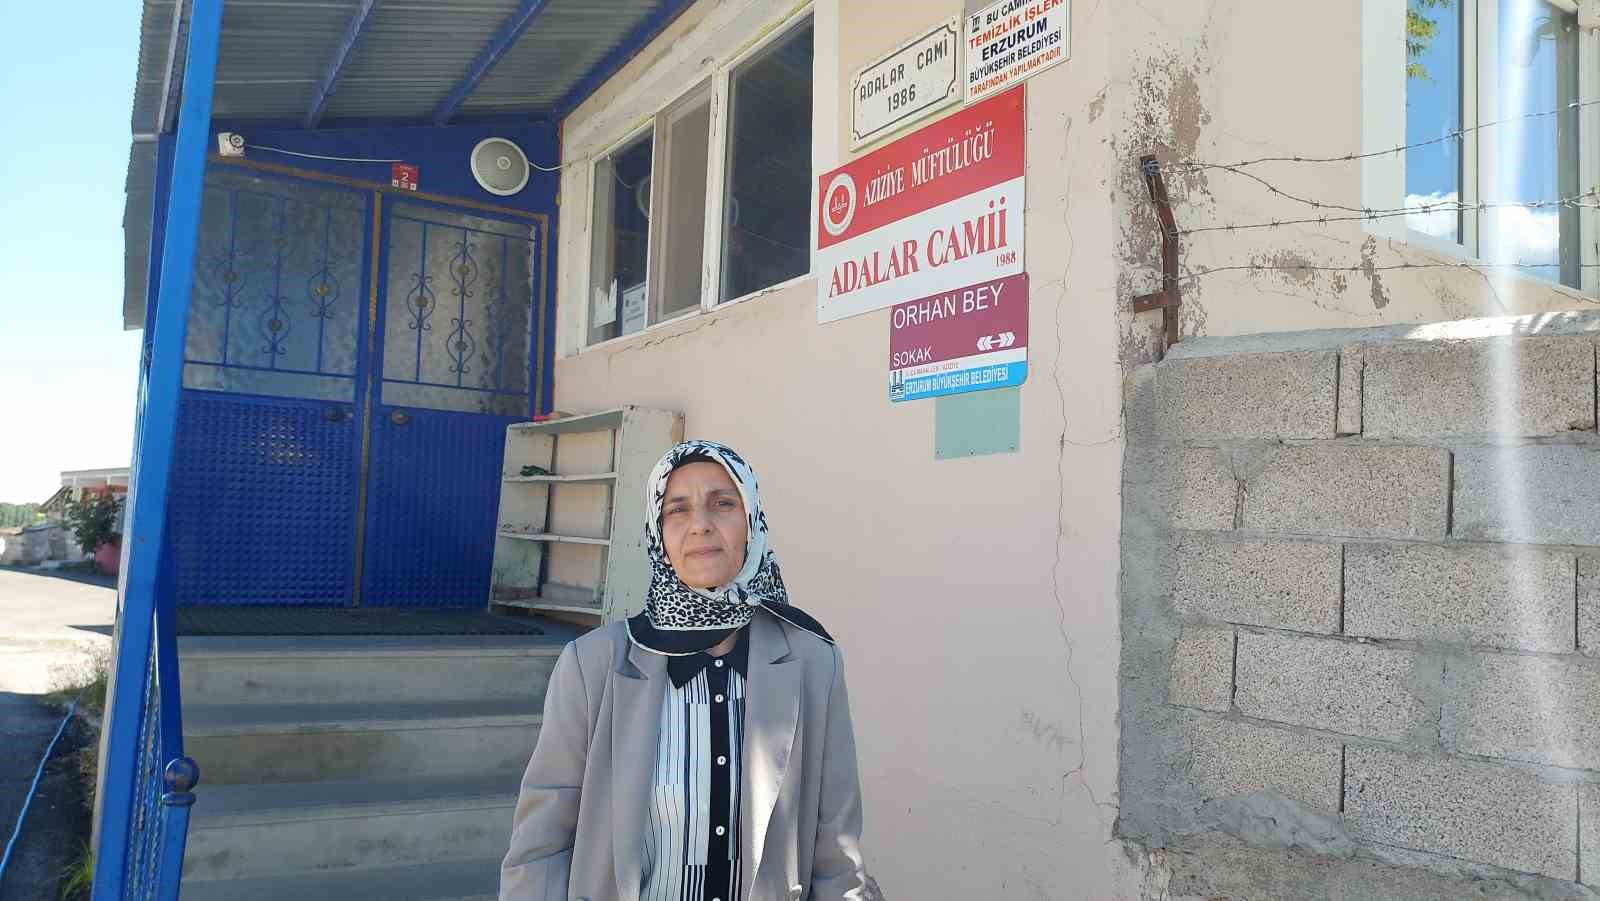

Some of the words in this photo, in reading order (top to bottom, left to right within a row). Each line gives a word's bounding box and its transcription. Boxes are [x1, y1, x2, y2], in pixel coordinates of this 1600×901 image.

[969, 14, 1020, 49] TEMİZLİK
[1024, 0, 1063, 21] İŞLER
[982, 17, 1047, 61] ERZURUM
[986, 8, 998, 25] BU
[860, 63, 904, 101] ADALAR
[917, 33, 947, 70] CAMİ
[969, 51, 1015, 83] BÜYÜKŞEHİR
[1017, 25, 1061, 61] BELEDİYESİ
[970, 71, 1008, 97] TARAFINDAN
[1010, 46, 1061, 77] YAPILMAKTADIR
[887, 83, 916, 112] 1986
[863, 164, 905, 208] AZİZİYE
[911, 120, 994, 188] MÜFTÜLÜĞÜ
[828, 238, 919, 298] ADALAR
[927, 196, 1008, 268] CAMİİ
[995, 251, 1016, 267] 1988
[894, 294, 957, 329] ORHAN
[962, 282, 1004, 313] BEY
[893, 345, 932, 367] SOKAK
